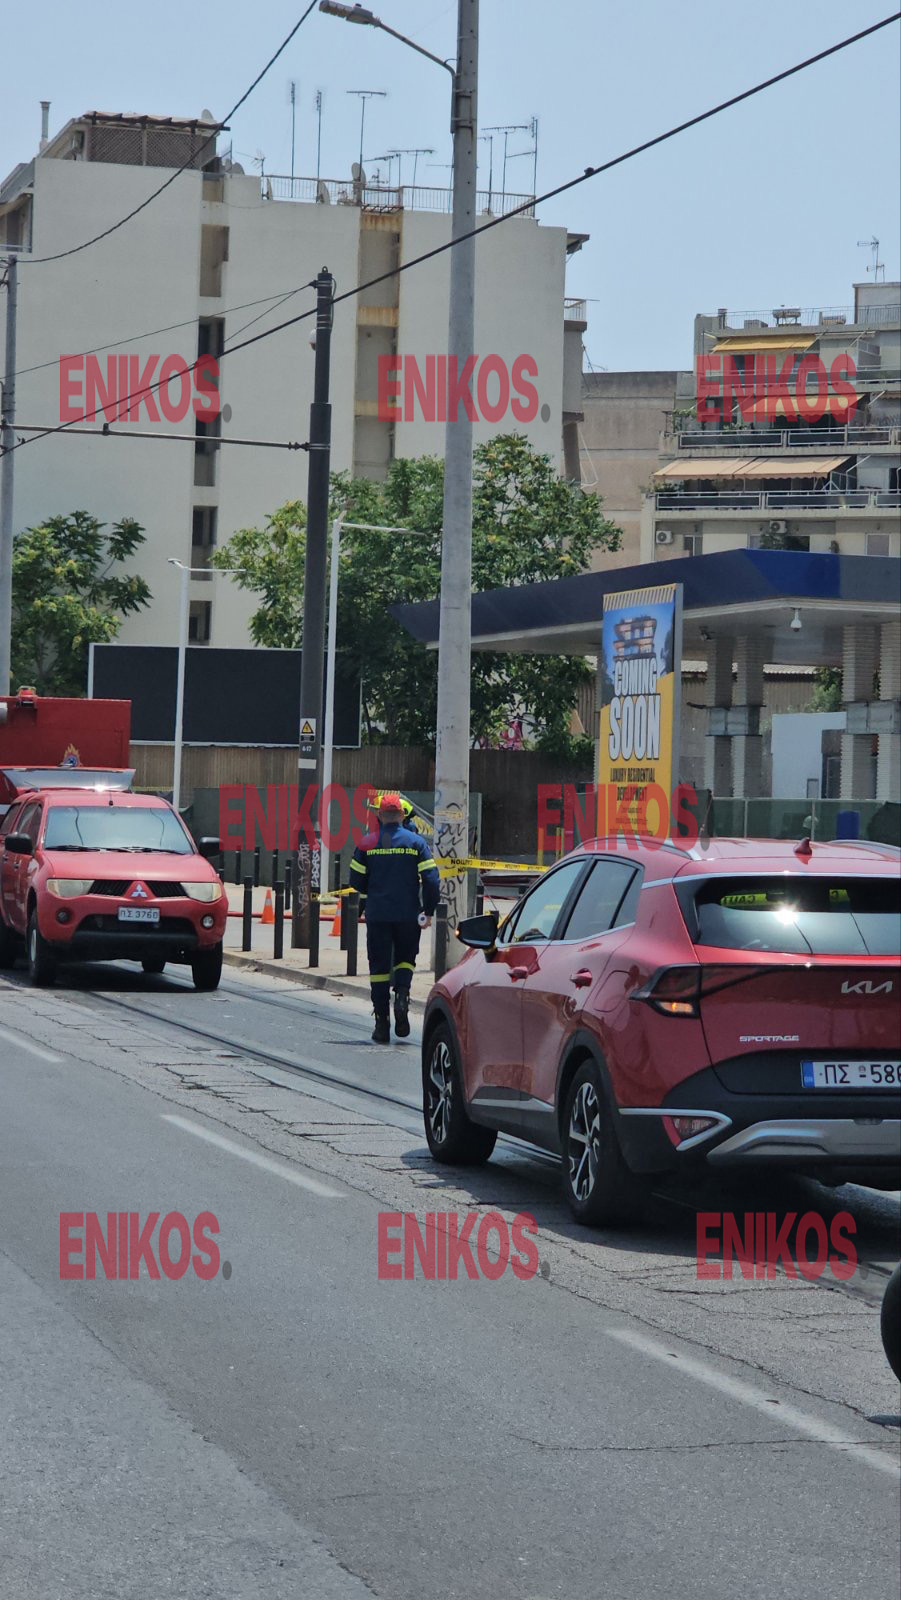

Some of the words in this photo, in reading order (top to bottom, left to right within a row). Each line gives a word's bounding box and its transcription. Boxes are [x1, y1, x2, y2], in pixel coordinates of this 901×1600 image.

[614, 658, 657, 696] COMING
[609, 695, 660, 760] SOON
[610, 767, 626, 782] LUXURY
[627, 767, 656, 783] RESIDENTIAL
[617, 786, 648, 802] DEVELOPMENT
[841, 980, 893, 994] KIA
